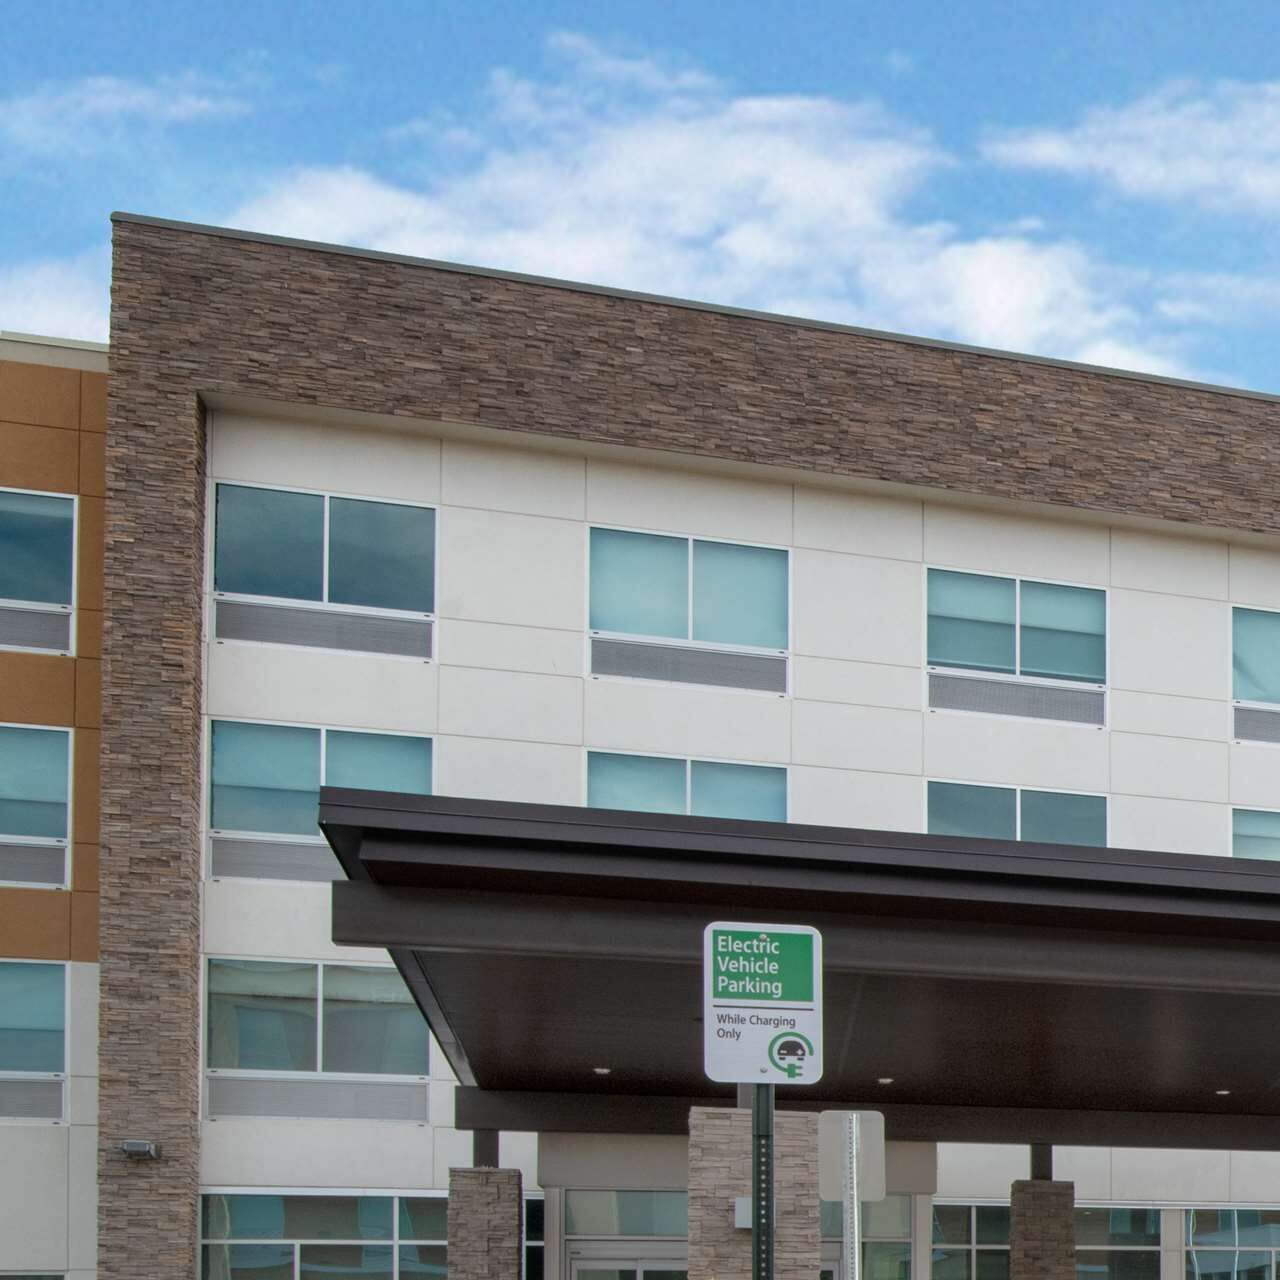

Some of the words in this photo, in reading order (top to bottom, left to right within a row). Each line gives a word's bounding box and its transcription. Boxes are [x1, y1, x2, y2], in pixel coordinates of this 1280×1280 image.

[717, 935, 780, 954] Electric
[717, 956, 779, 974] Vehicle
[717, 976, 782, 998] Parking
[716, 1013, 747, 1025] While
[749, 1014, 796, 1029] Charging
[716, 1028, 741, 1041] Only
